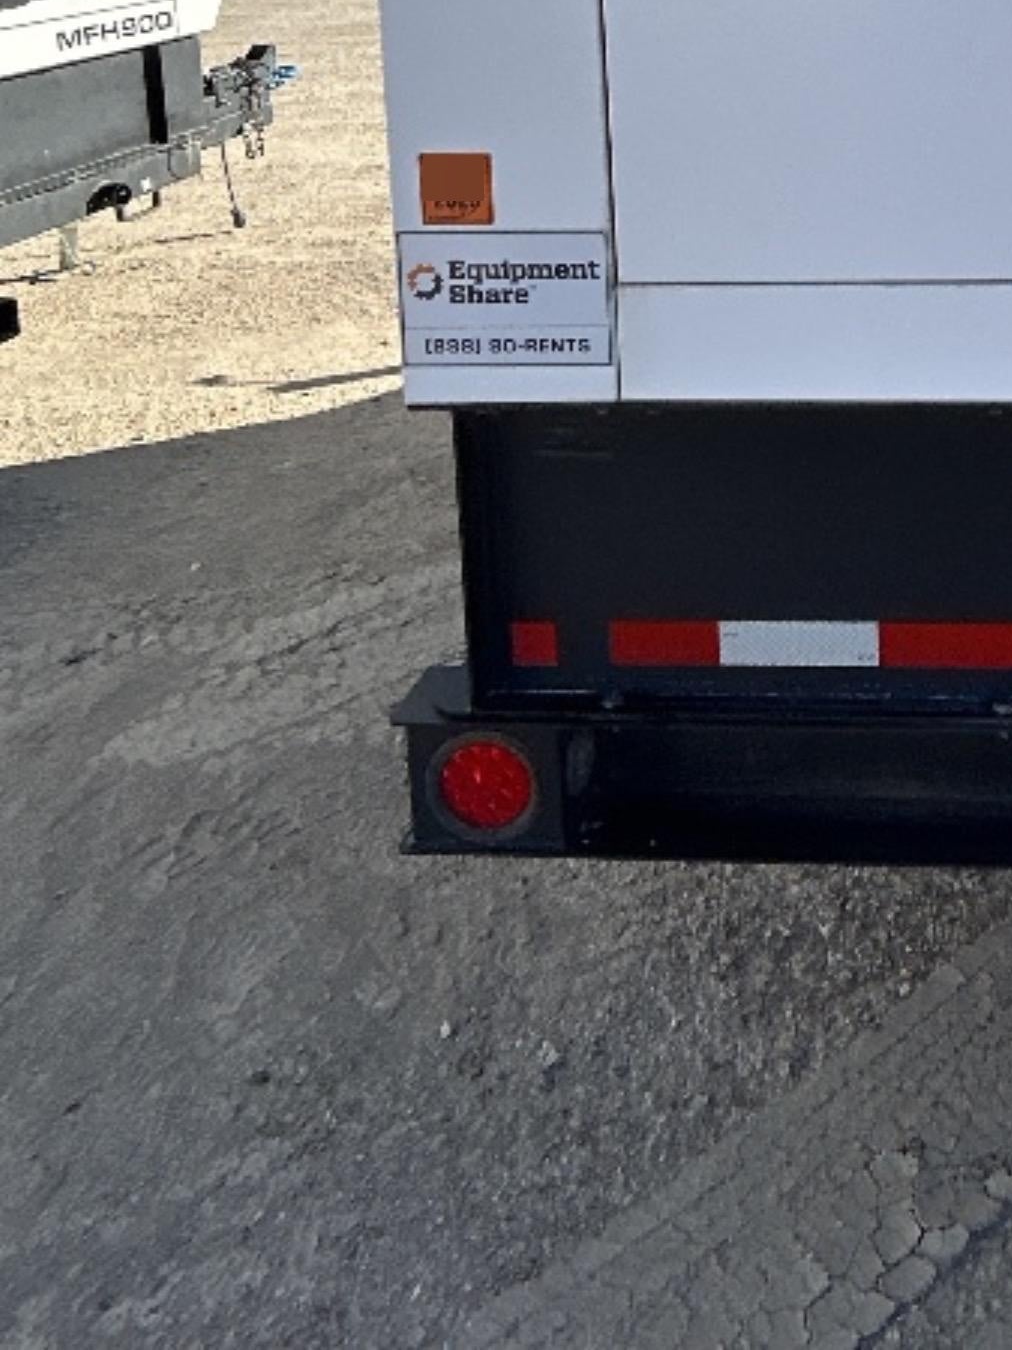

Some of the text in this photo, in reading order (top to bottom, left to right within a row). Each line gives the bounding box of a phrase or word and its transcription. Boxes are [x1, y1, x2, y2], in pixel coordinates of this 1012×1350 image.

[56, 11, 172, 52] MFH900
[447, 260, 600, 284] Equipment
[449, 285, 529, 303] Share
[488, 338, 592, 354] 80-RENTS
